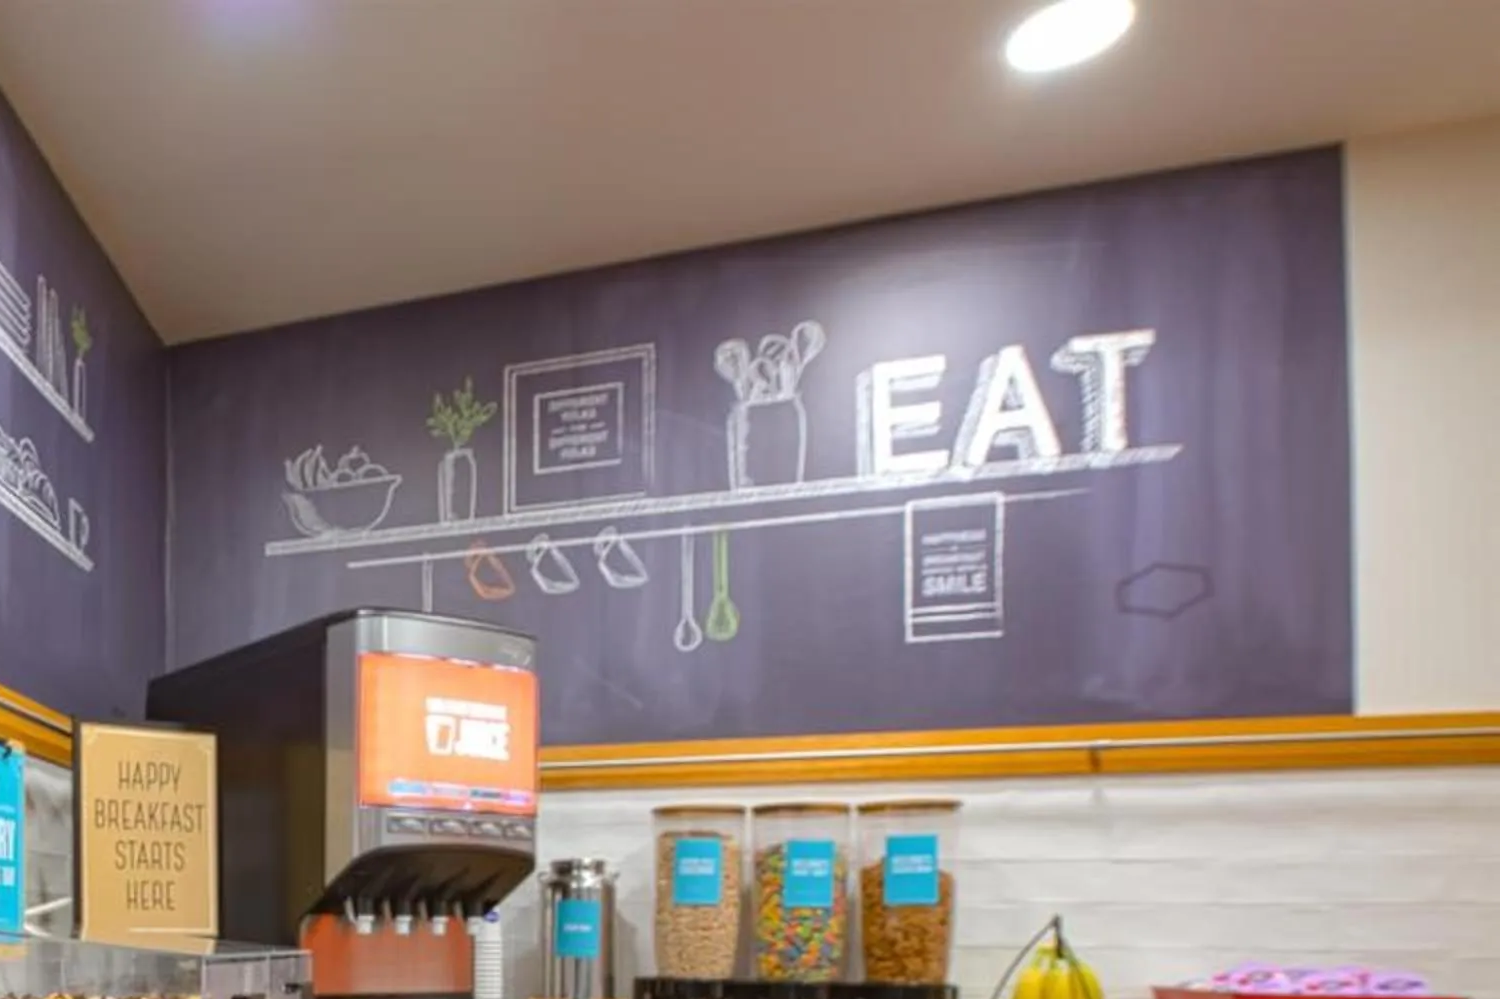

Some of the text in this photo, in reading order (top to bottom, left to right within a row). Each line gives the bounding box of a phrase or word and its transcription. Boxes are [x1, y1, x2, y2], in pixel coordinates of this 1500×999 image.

[857, 329, 1156, 480] EAT
[117, 760, 182, 792] HAPPY
[93, 798, 205, 833] BREAKFAST
[114, 839, 186, 872] STARTS
[125, 879, 176, 911] HERE
